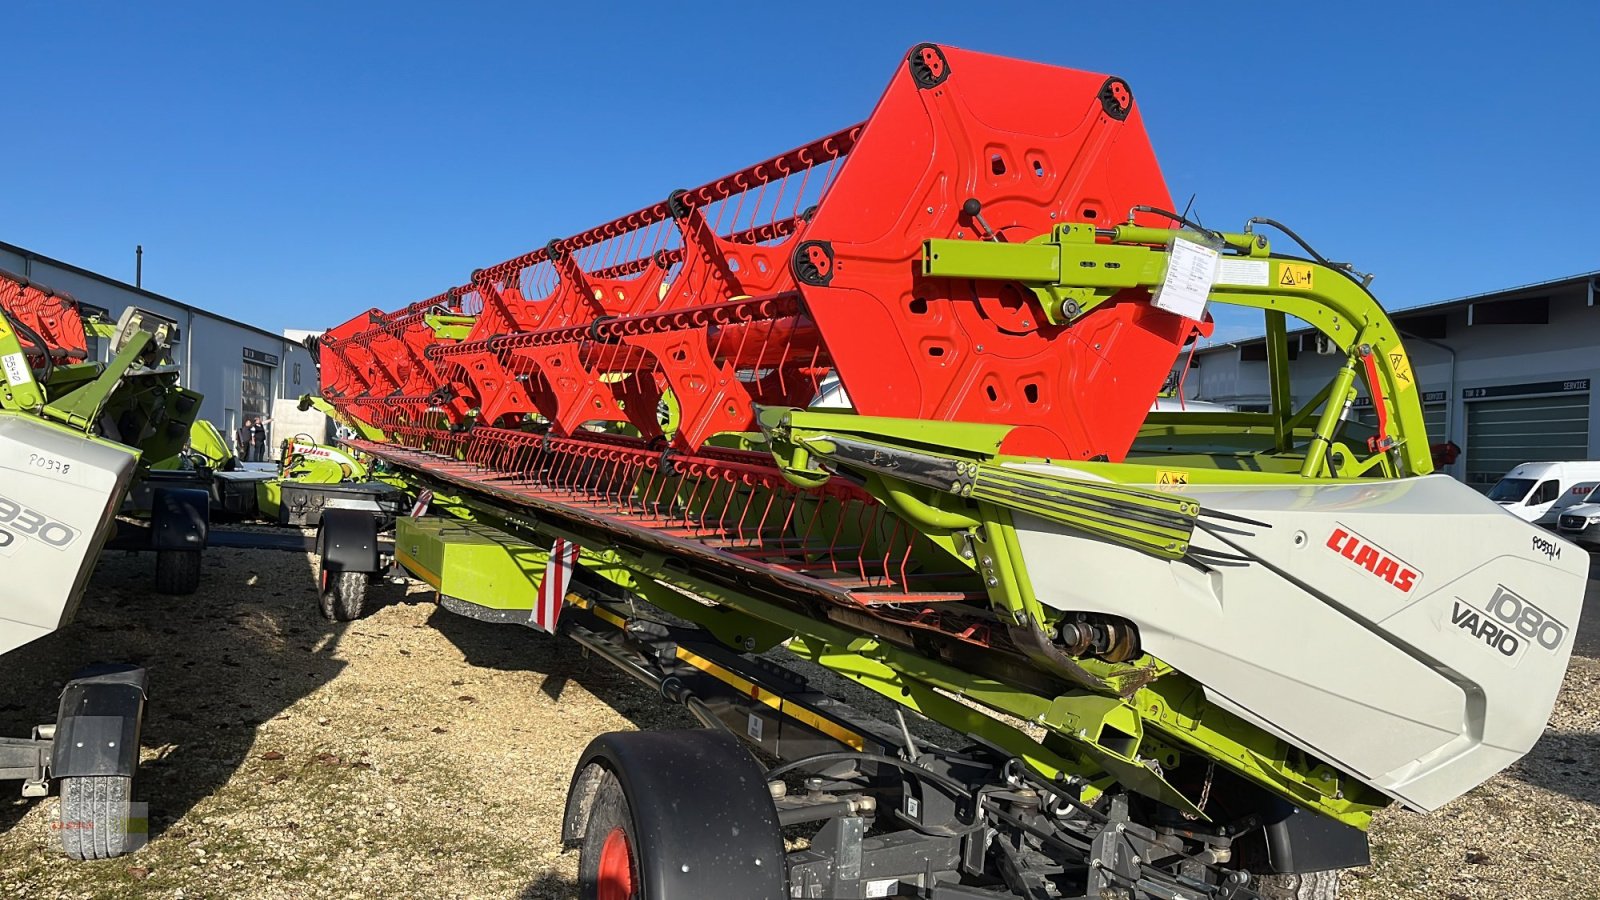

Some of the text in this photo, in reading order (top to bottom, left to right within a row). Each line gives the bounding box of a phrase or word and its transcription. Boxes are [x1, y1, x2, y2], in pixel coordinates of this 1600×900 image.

[1563, 381, 1587, 390] SERVICE
[1326, 528, 1417, 593] CLAAS
[1451, 601, 1519, 657] VARIO
[1485, 588, 1564, 650] 1080
